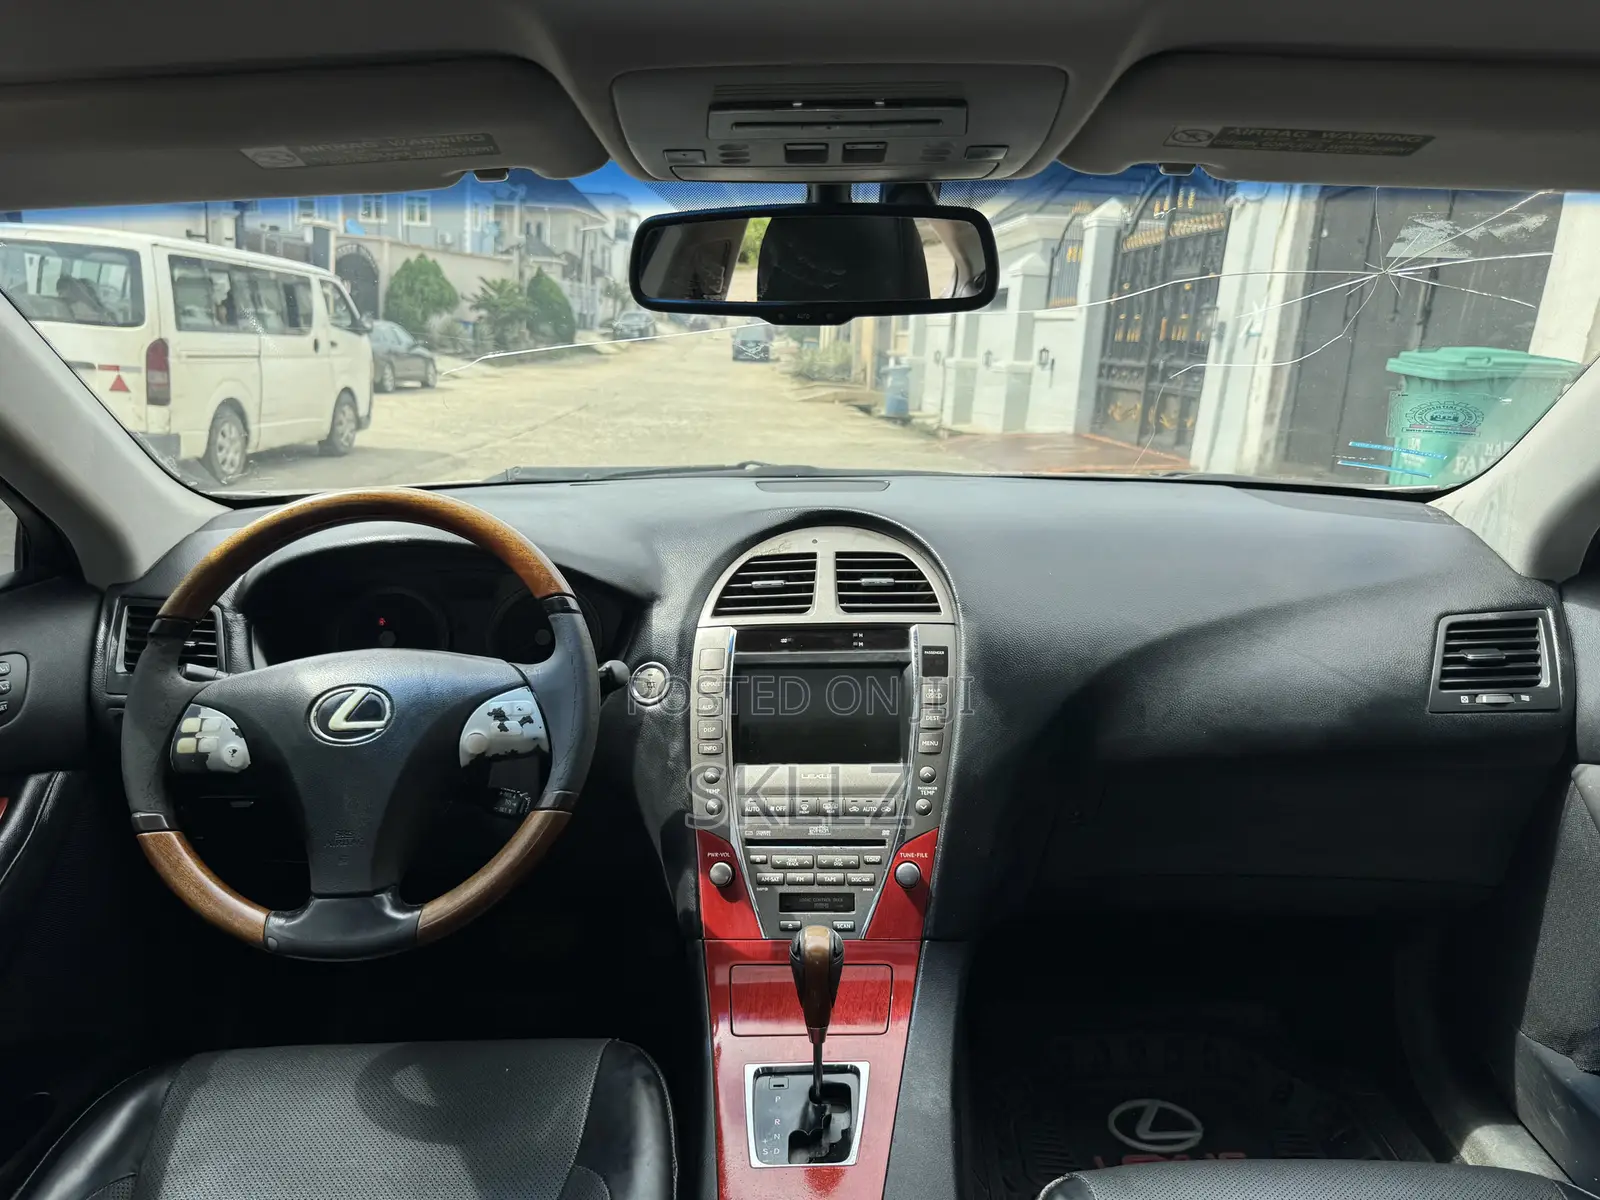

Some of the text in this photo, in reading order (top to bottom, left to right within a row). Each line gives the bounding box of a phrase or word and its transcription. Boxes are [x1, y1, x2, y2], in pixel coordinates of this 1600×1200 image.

[387, 134, 487, 148] WARNING
[1228, 127, 1424, 144] AIRBAG WARNING
[775, 1095, 781, 1103] P
